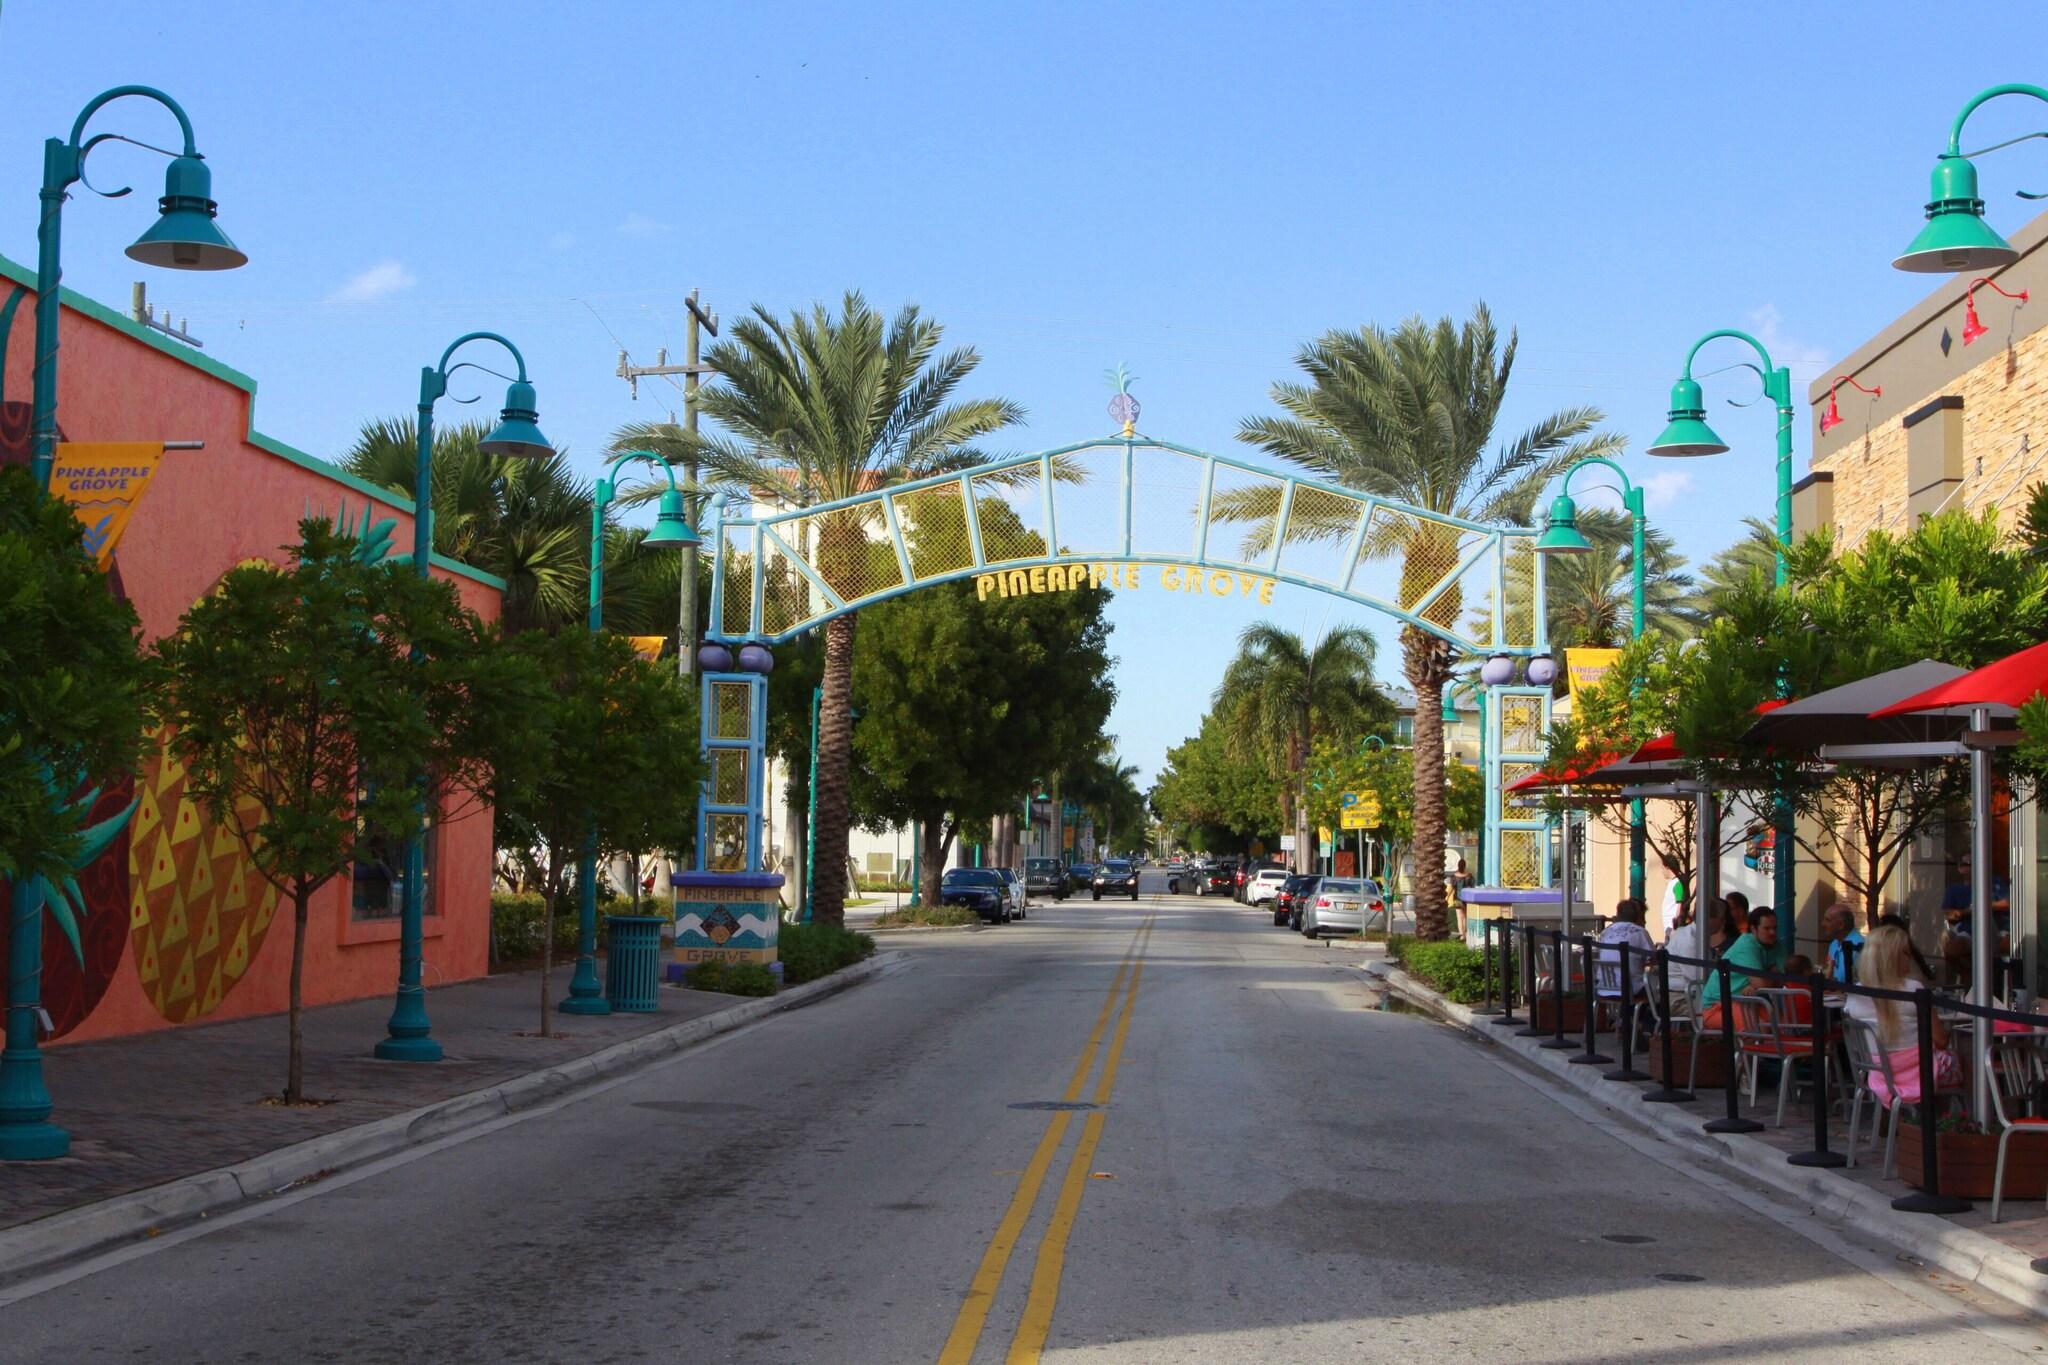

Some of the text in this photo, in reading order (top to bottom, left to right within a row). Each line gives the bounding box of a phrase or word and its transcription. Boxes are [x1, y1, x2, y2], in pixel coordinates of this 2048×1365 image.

[56, 467, 150, 478] PINEAPPLE
[69, 479, 128, 490] GROVE
[976, 563, 1277, 606] PINEAPPLE GROVE
[1343, 793, 1358, 808] P
[684, 888, 760, 901] PINEAPPLE
[687, 950, 751, 962] GROVE
